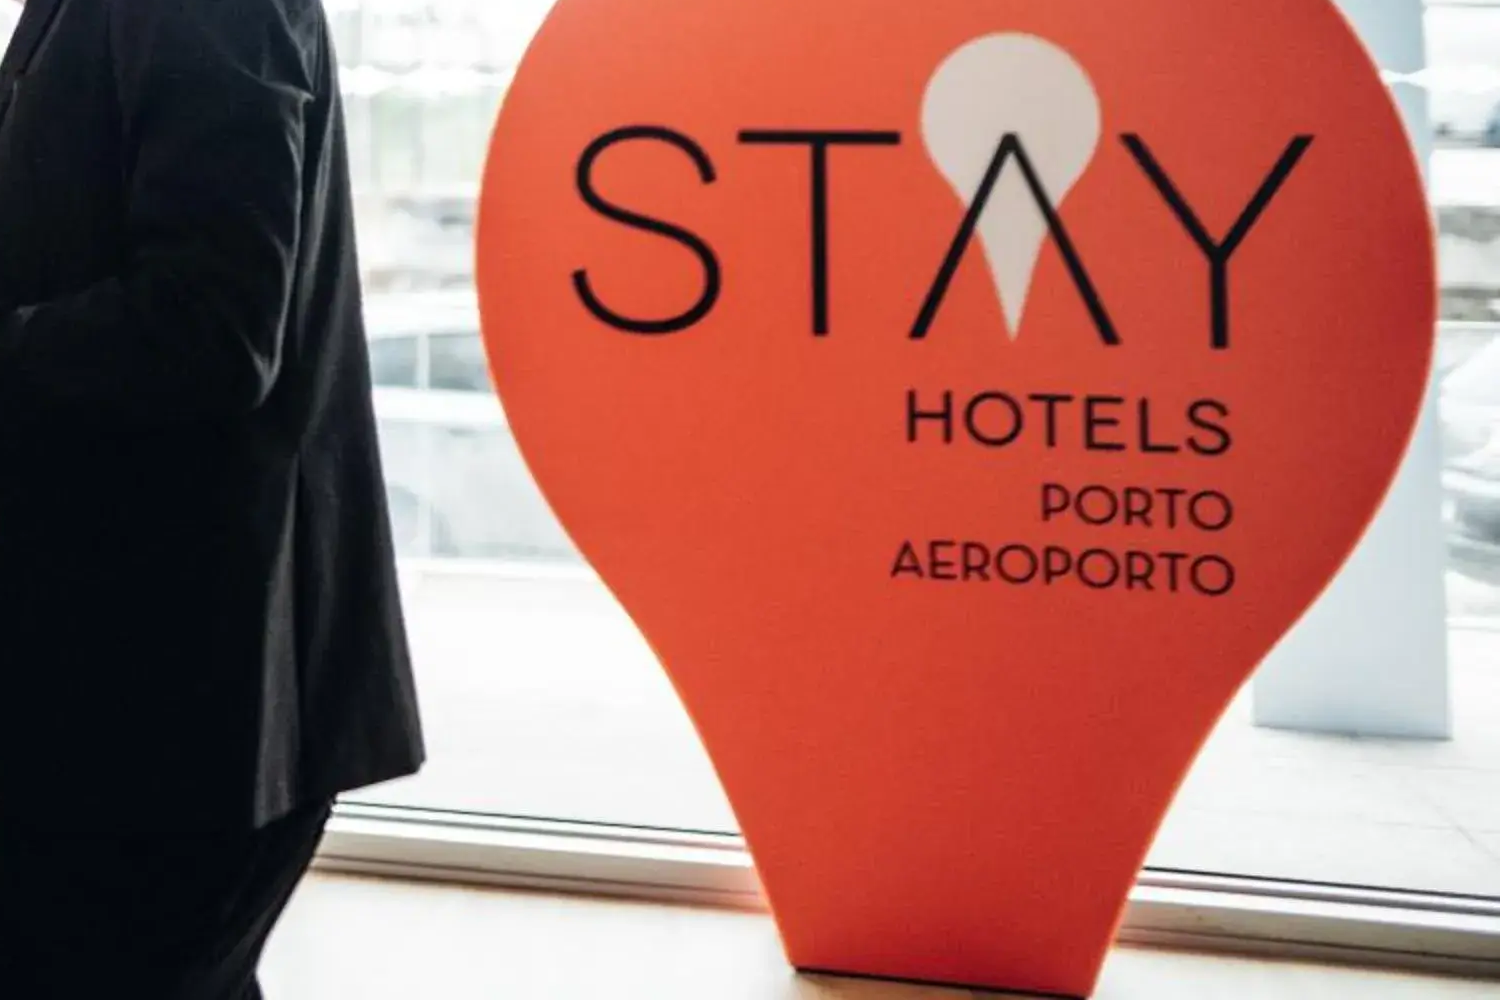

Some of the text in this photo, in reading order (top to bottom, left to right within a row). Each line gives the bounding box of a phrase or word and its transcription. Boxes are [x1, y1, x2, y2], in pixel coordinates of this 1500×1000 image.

[572, 125, 1315, 349] STAY
[906, 390, 1232, 456] HOTELS
[1041, 484, 1233, 532] PORTO
[891, 541, 1235, 597] AEROPORTO
